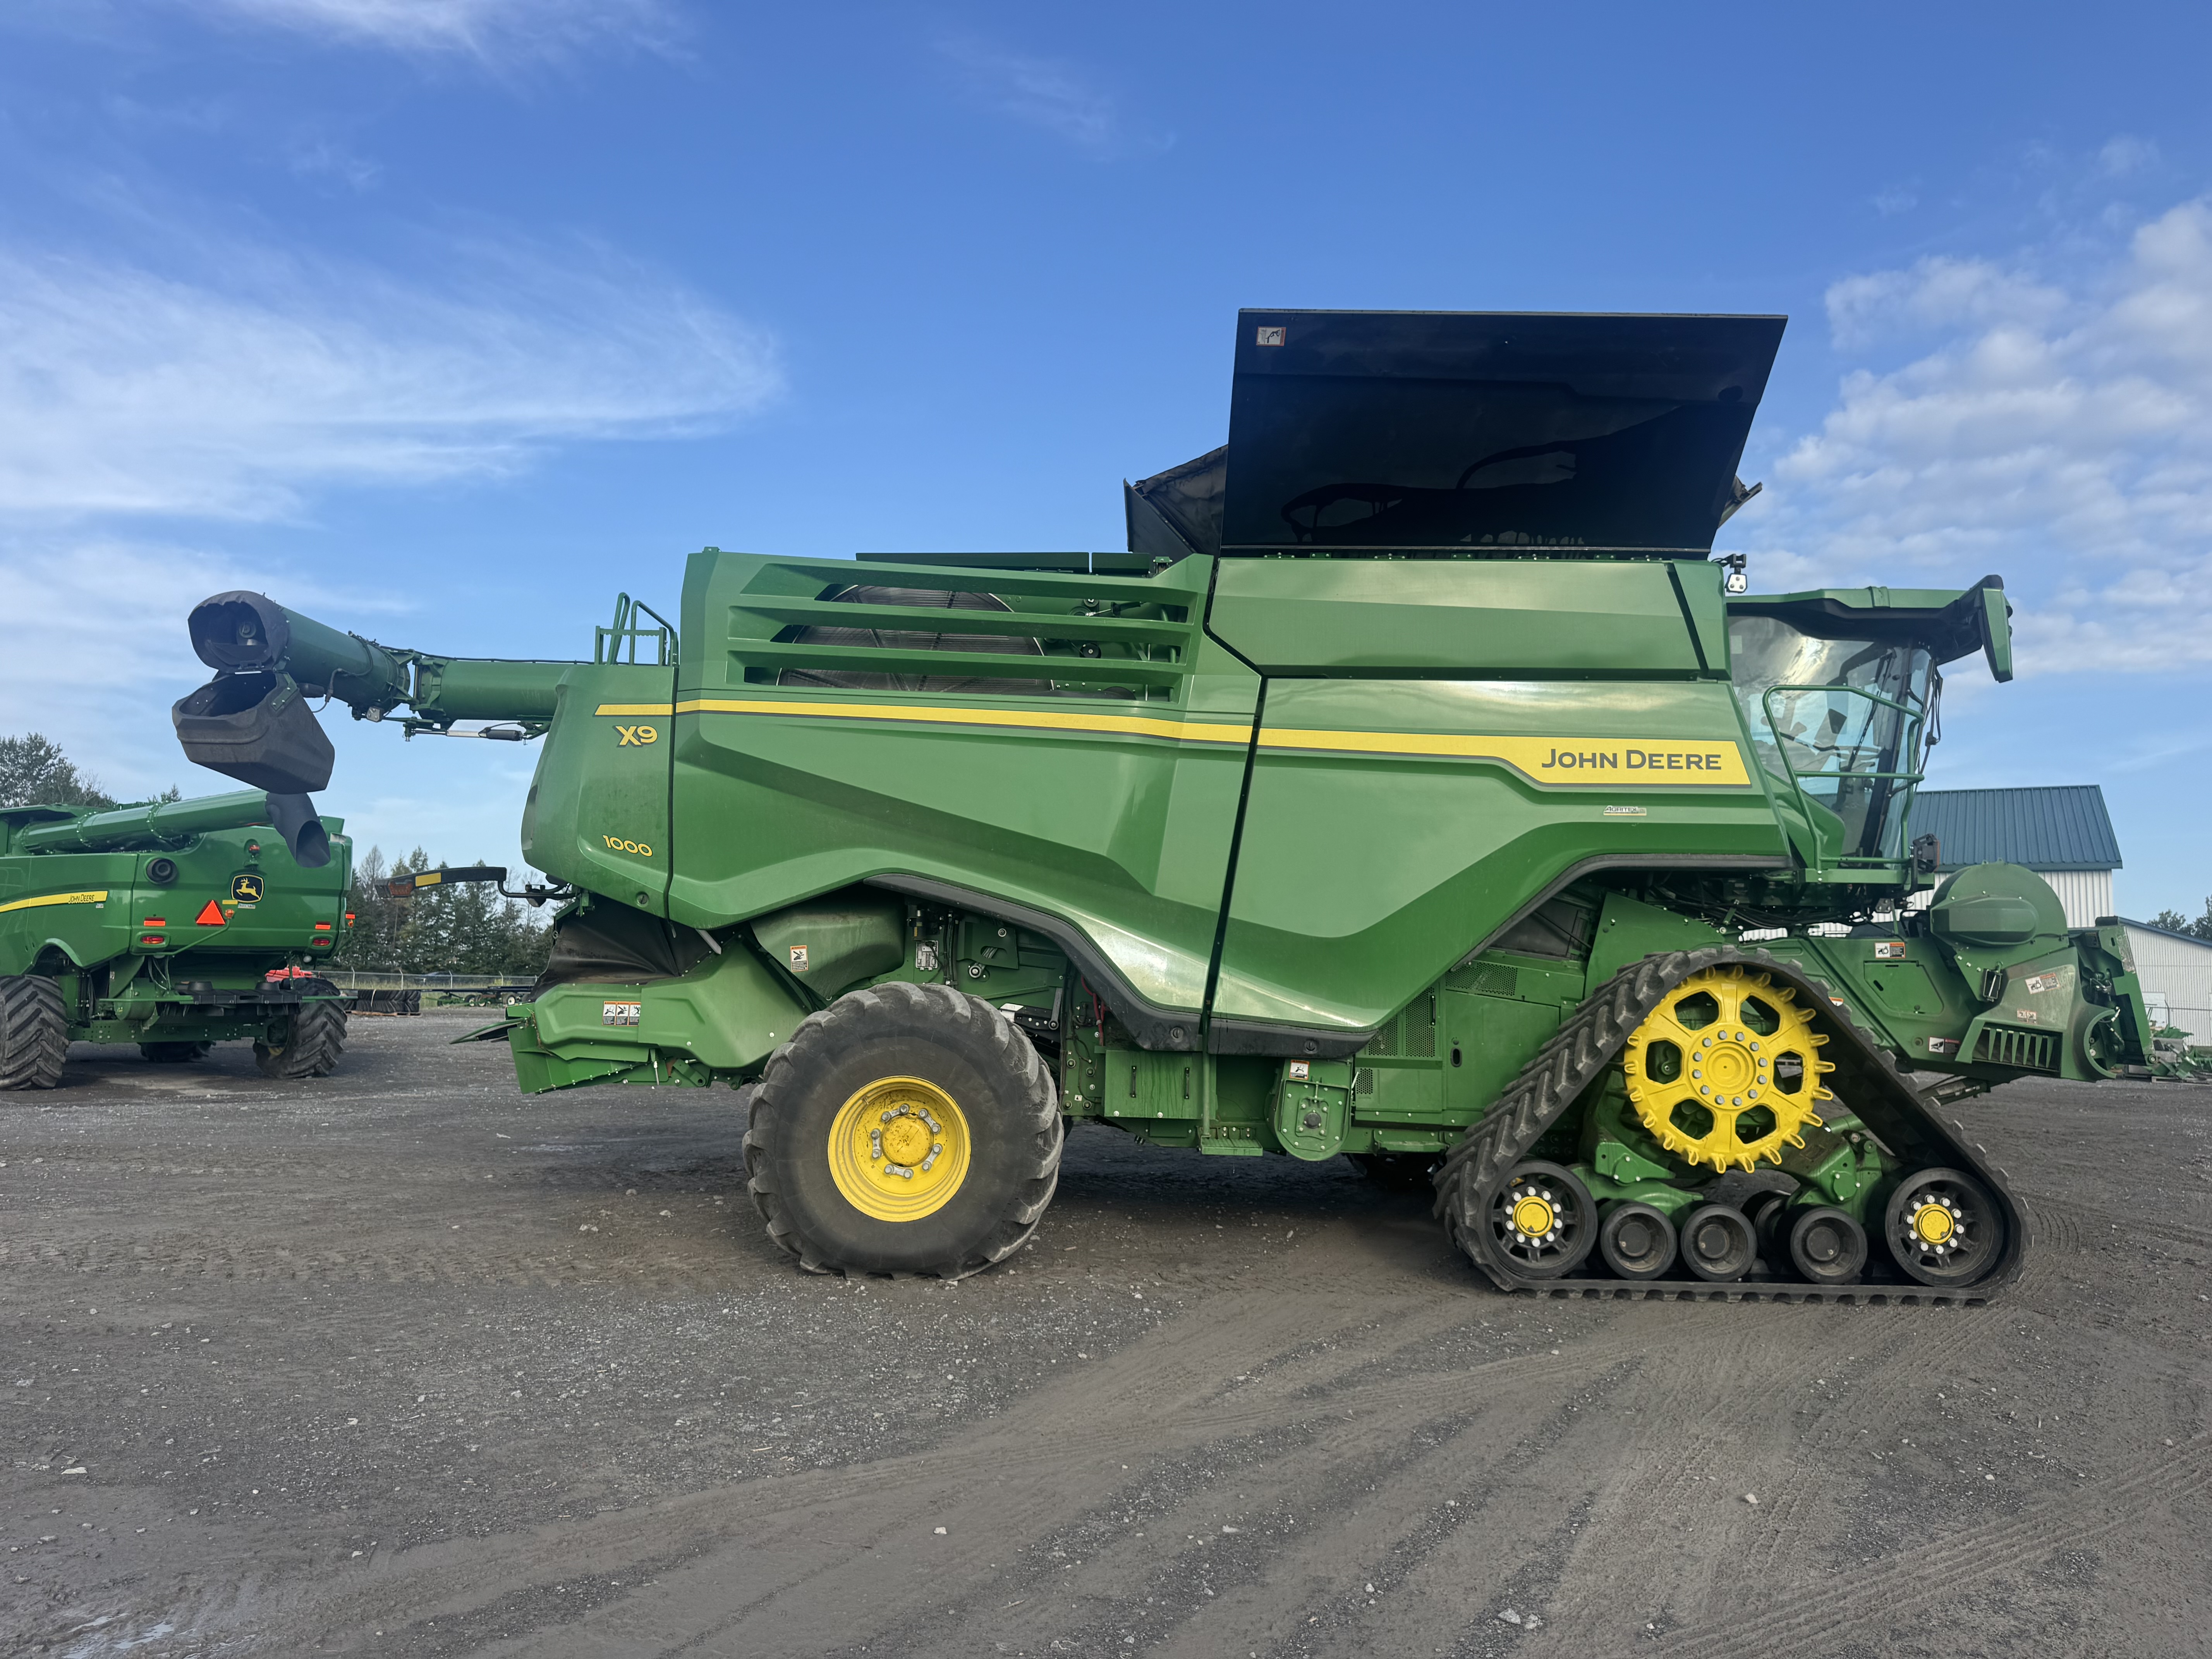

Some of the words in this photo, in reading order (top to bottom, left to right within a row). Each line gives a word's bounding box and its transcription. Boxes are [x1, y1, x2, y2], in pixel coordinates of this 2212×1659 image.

[615, 725, 658, 746] X9
[1541, 748, 1618, 769] JOHN
[1626, 749, 1722, 770] DEERE
[603, 835, 653, 856] 1000
